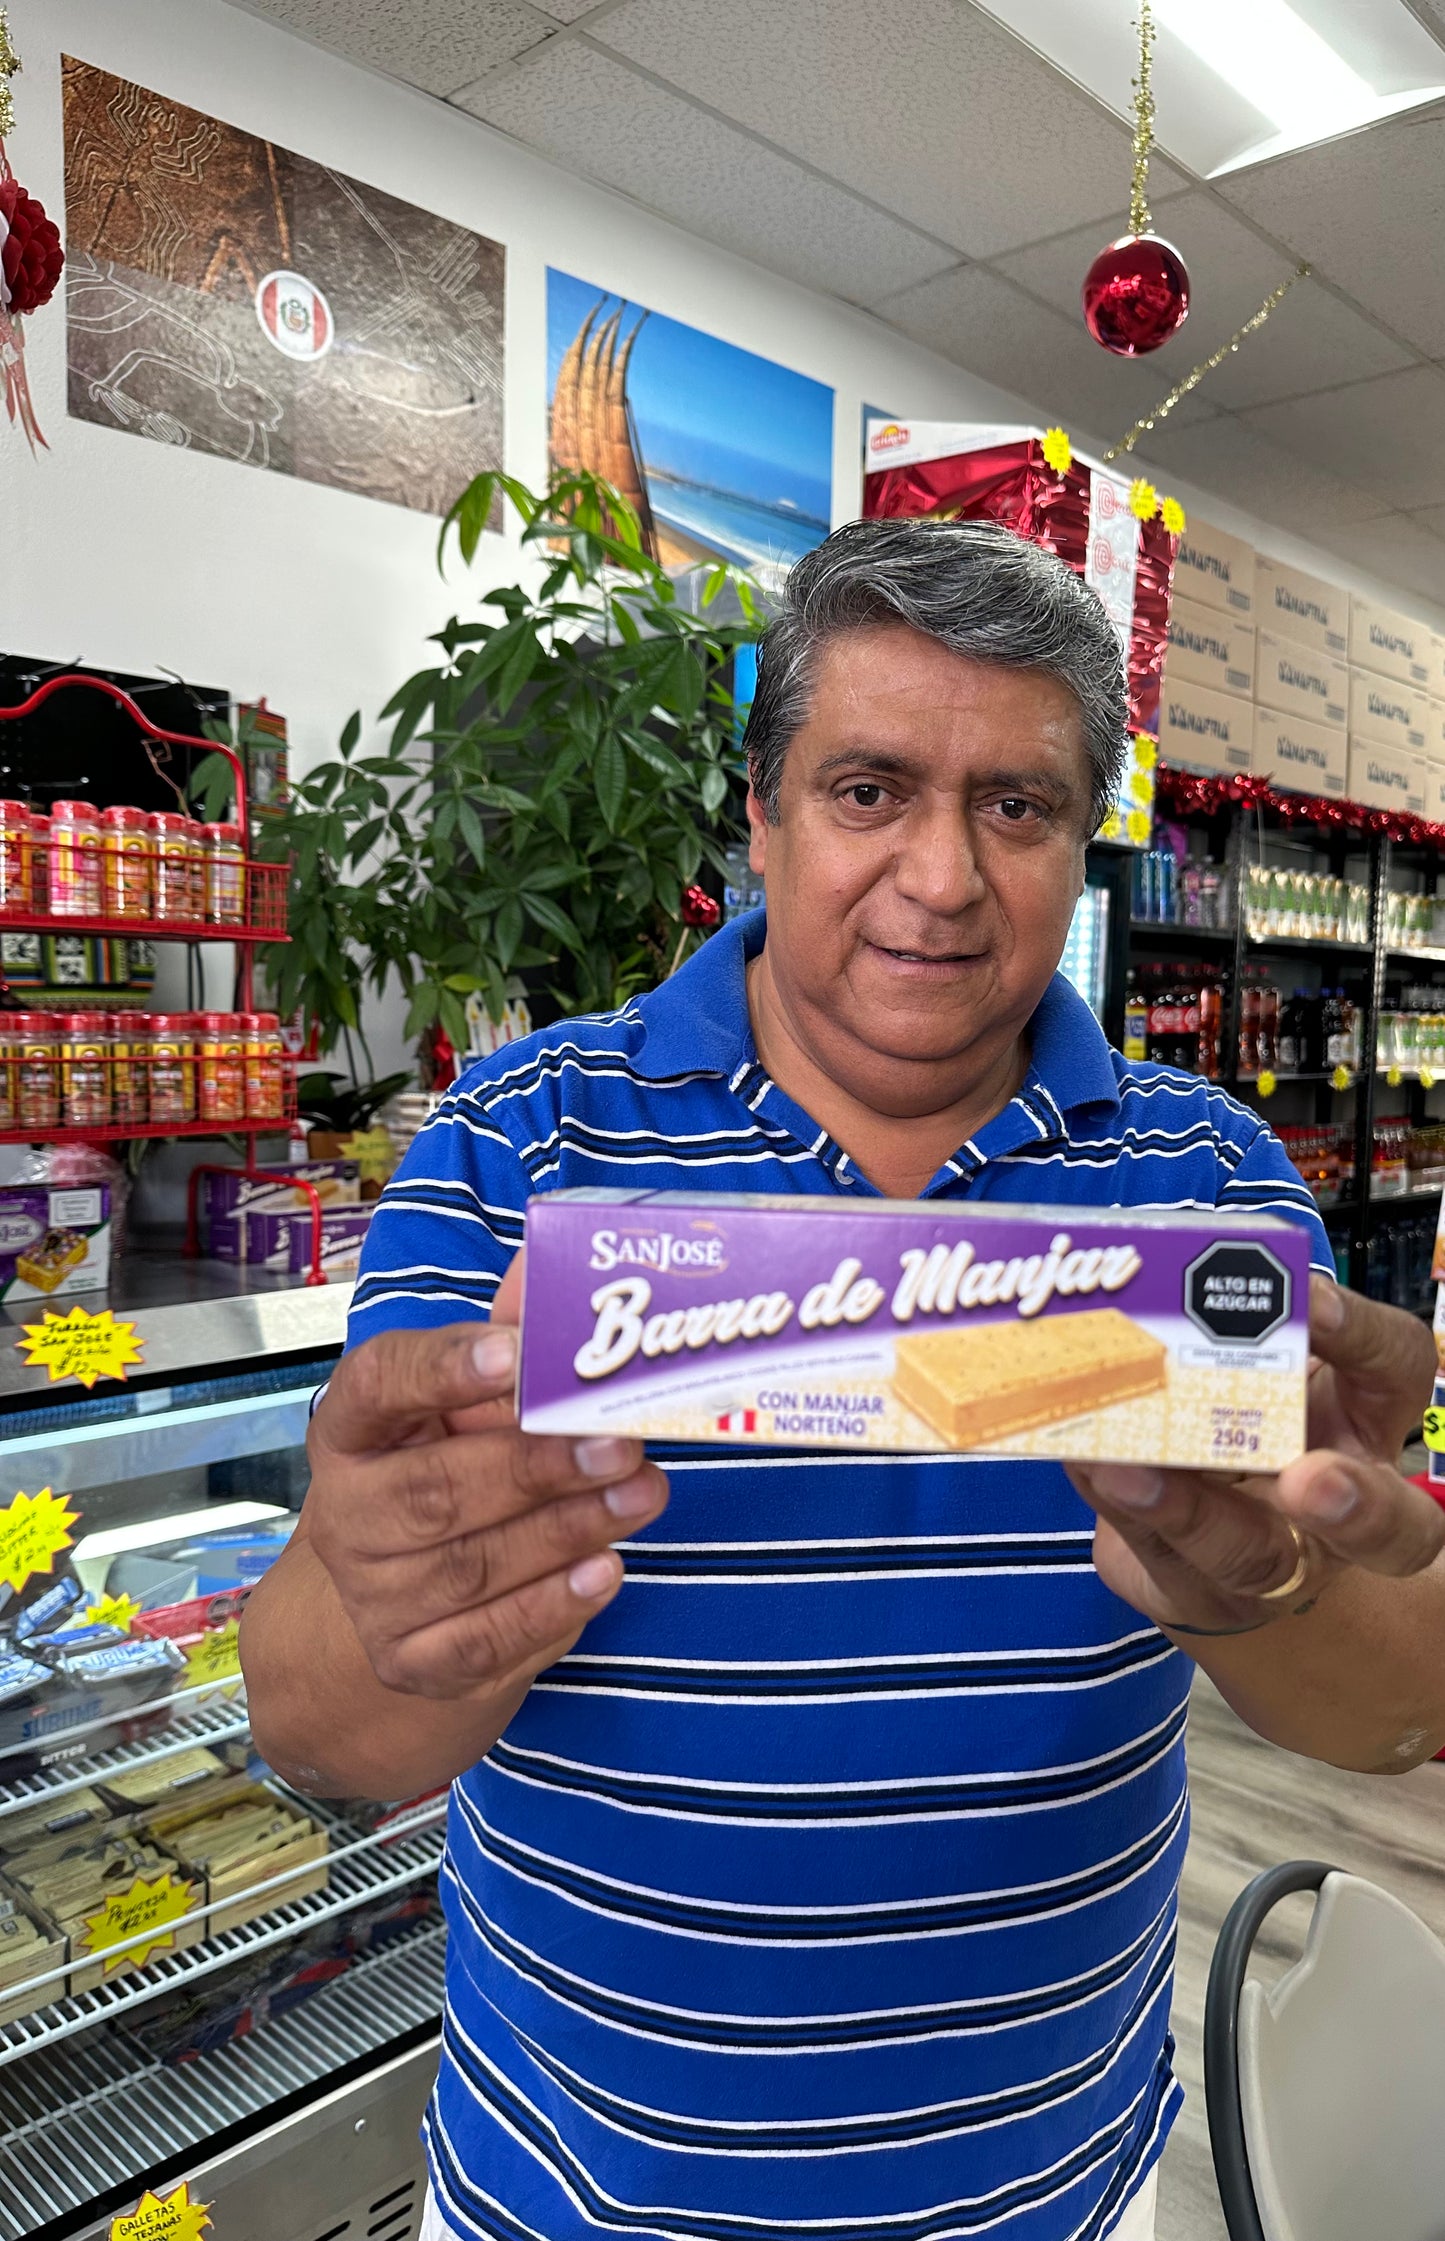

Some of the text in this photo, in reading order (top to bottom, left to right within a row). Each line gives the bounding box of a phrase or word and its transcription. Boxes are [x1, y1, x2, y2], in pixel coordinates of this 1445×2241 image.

[1203, 1275, 1274, 1295] ALTO EN
[573, 1232, 1142, 1379] Barra de Manjar
[757, 1390, 885, 1415] CON MANJAR
[774, 1413, 867, 1436] NORTEÑO
[119, 2201, 176, 2236] GALLETAS
[133, 2213, 183, 2241] TEJANAS
